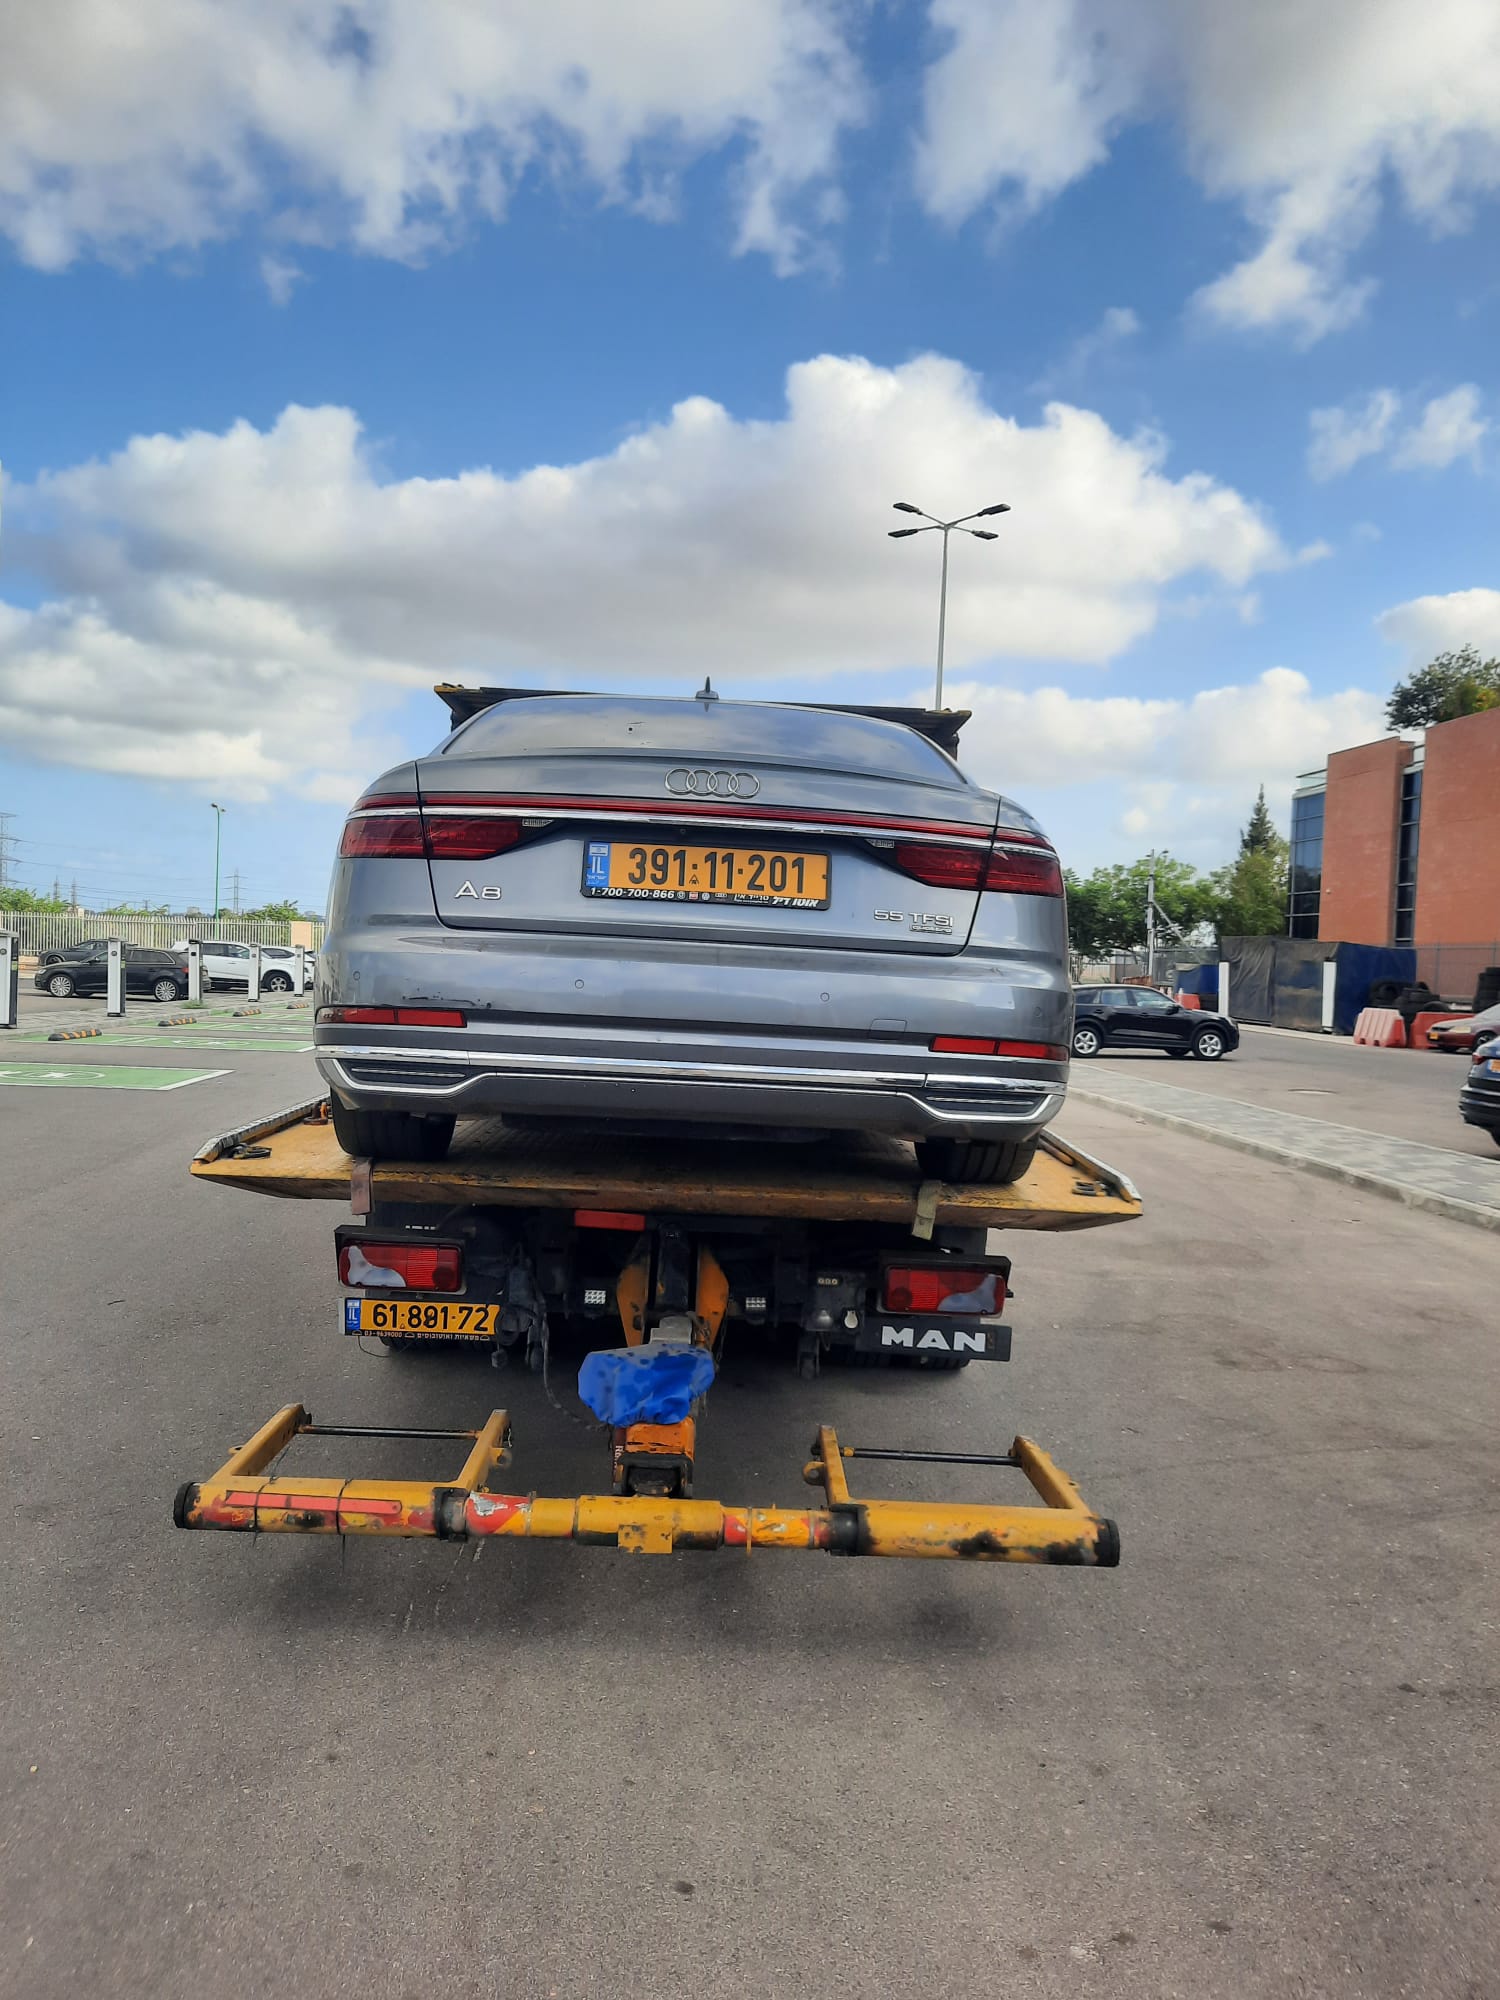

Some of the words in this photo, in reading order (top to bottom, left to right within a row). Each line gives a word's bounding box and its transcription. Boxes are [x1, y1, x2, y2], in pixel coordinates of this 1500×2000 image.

[592, 856, 604, 873] IL
[454, 880, 501, 900] A8
[591, 887, 675, 899] 1-700-700-866
[792, 897, 819, 908] אוטו
[874, 909, 904, 921] 55
[908, 912, 953, 928] TFSI
[882, 1326, 986, 1353] MAN
